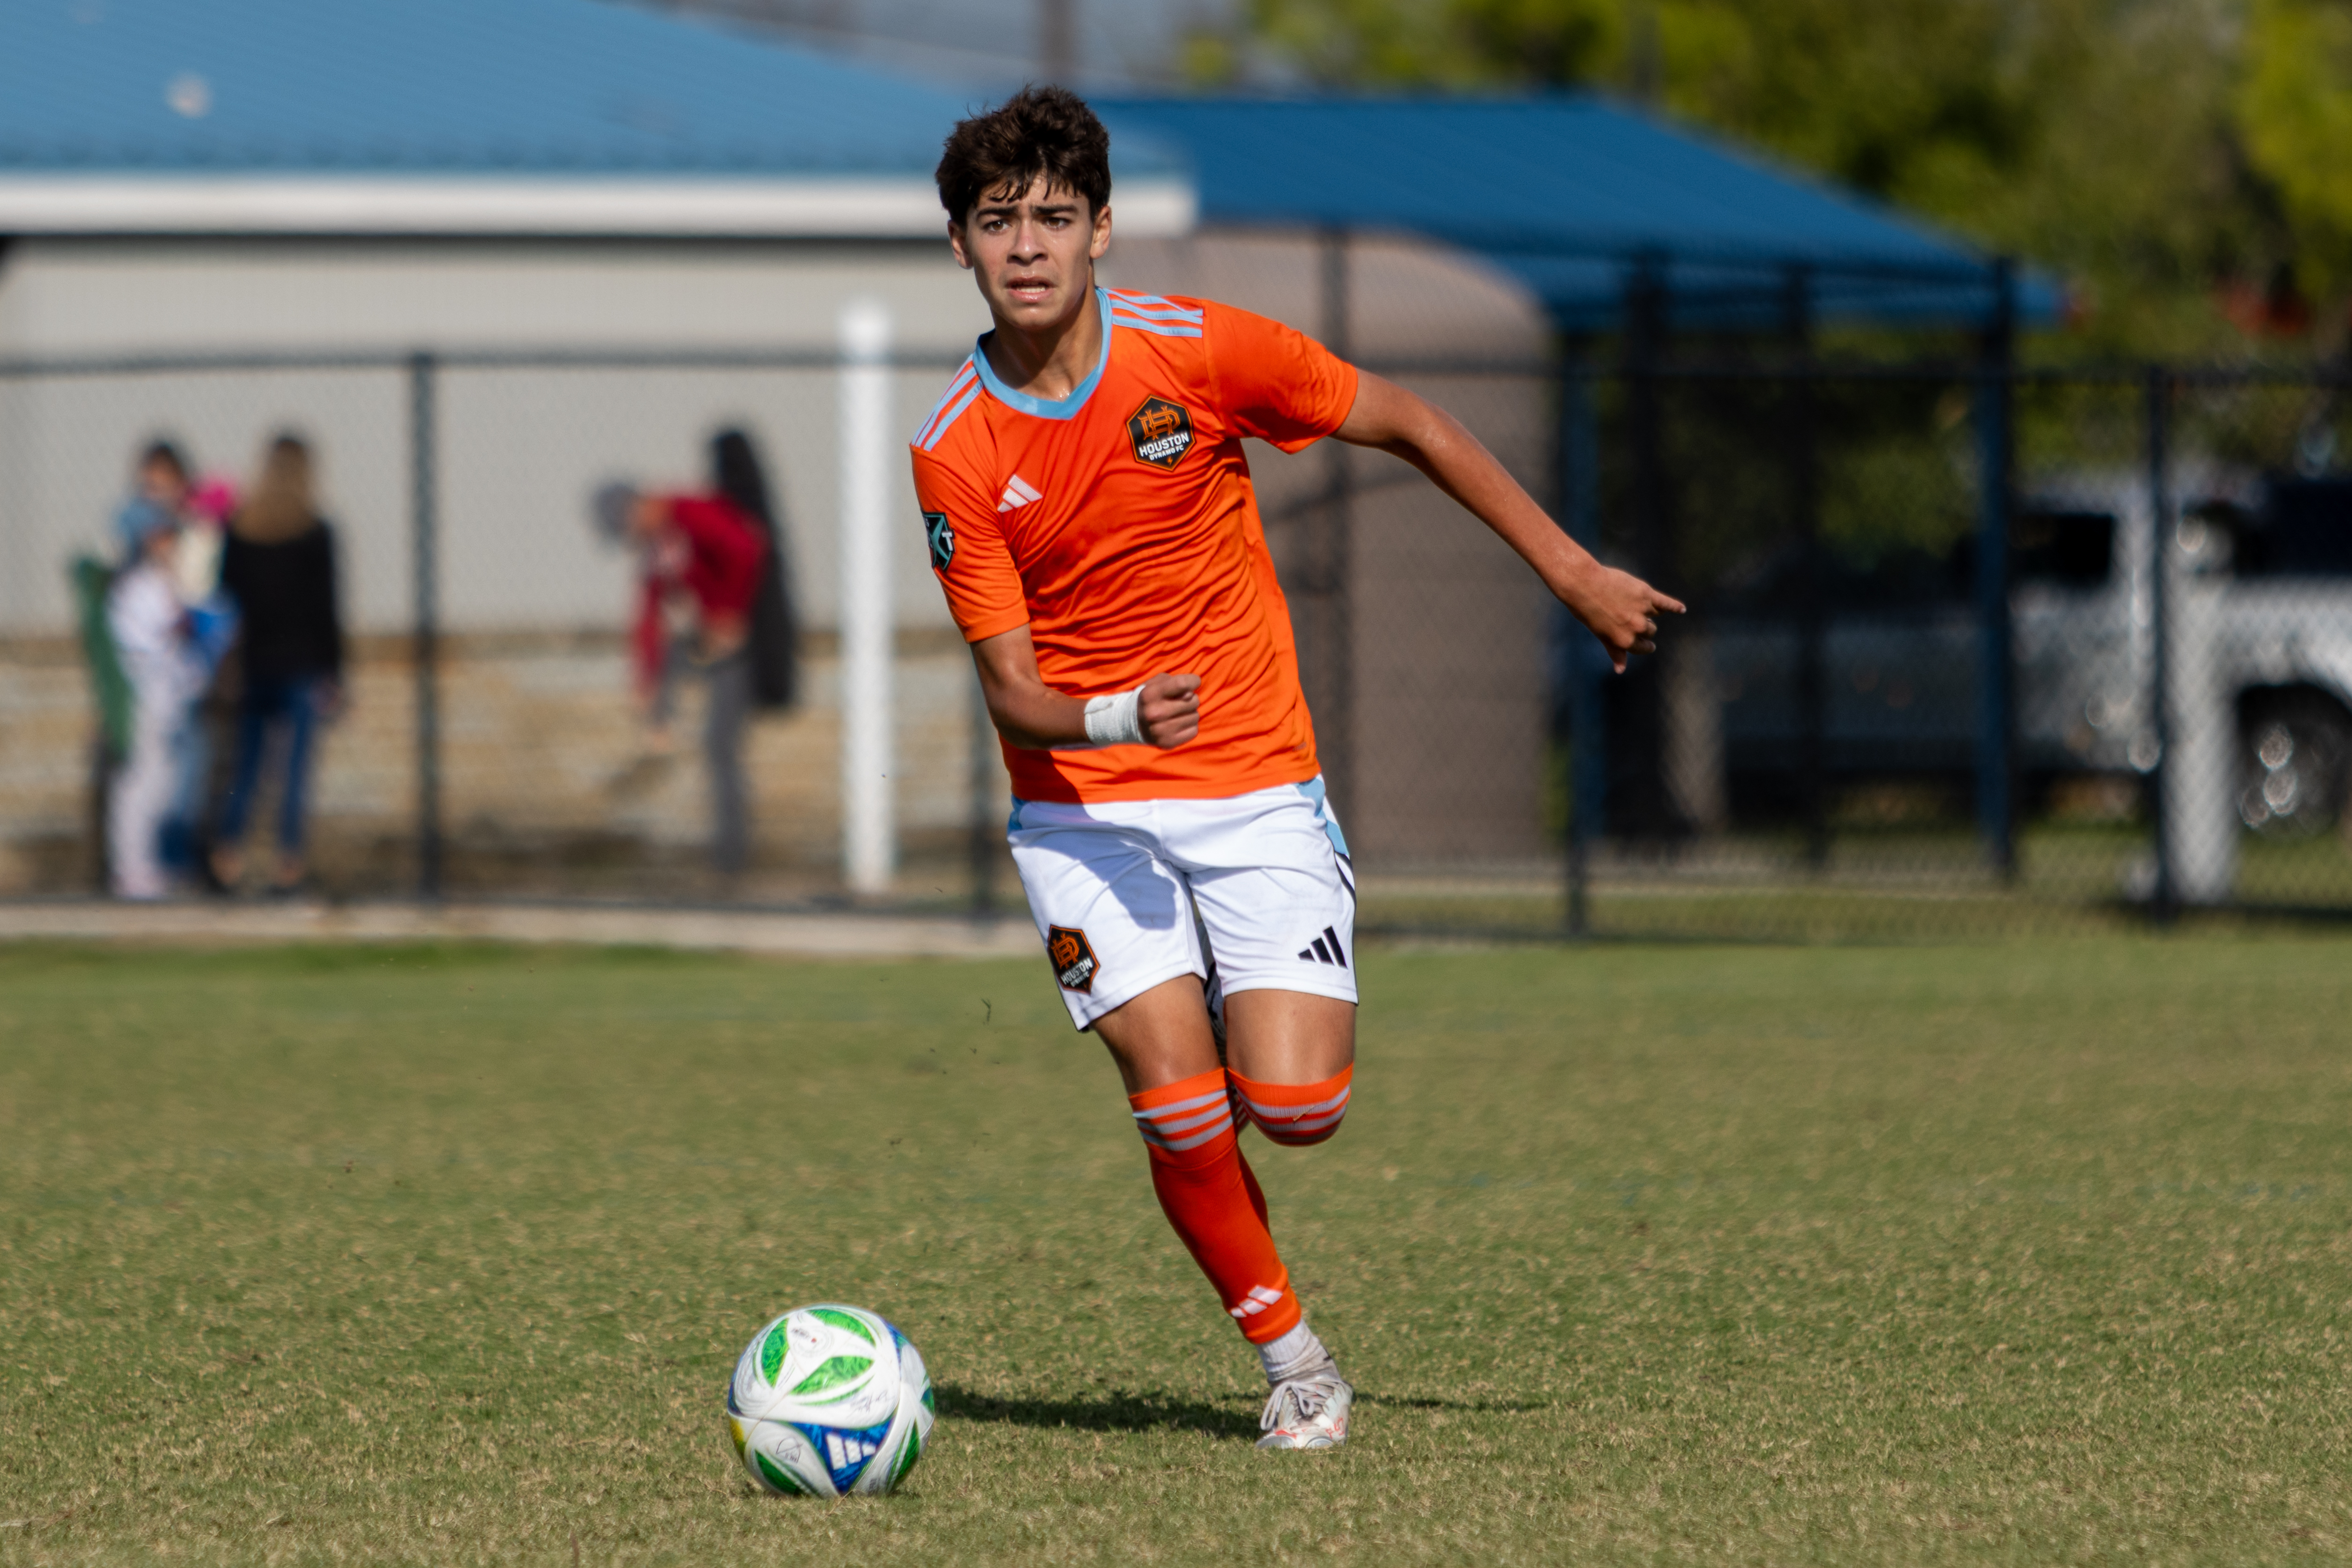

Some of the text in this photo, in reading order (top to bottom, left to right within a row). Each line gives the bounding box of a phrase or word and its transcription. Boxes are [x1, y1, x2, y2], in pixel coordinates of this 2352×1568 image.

[1139, 432, 1190, 457] HOUSTON
[1149, 448, 1176, 461] DYNAMO
[1060, 957, 1093, 986] HOUSTON
